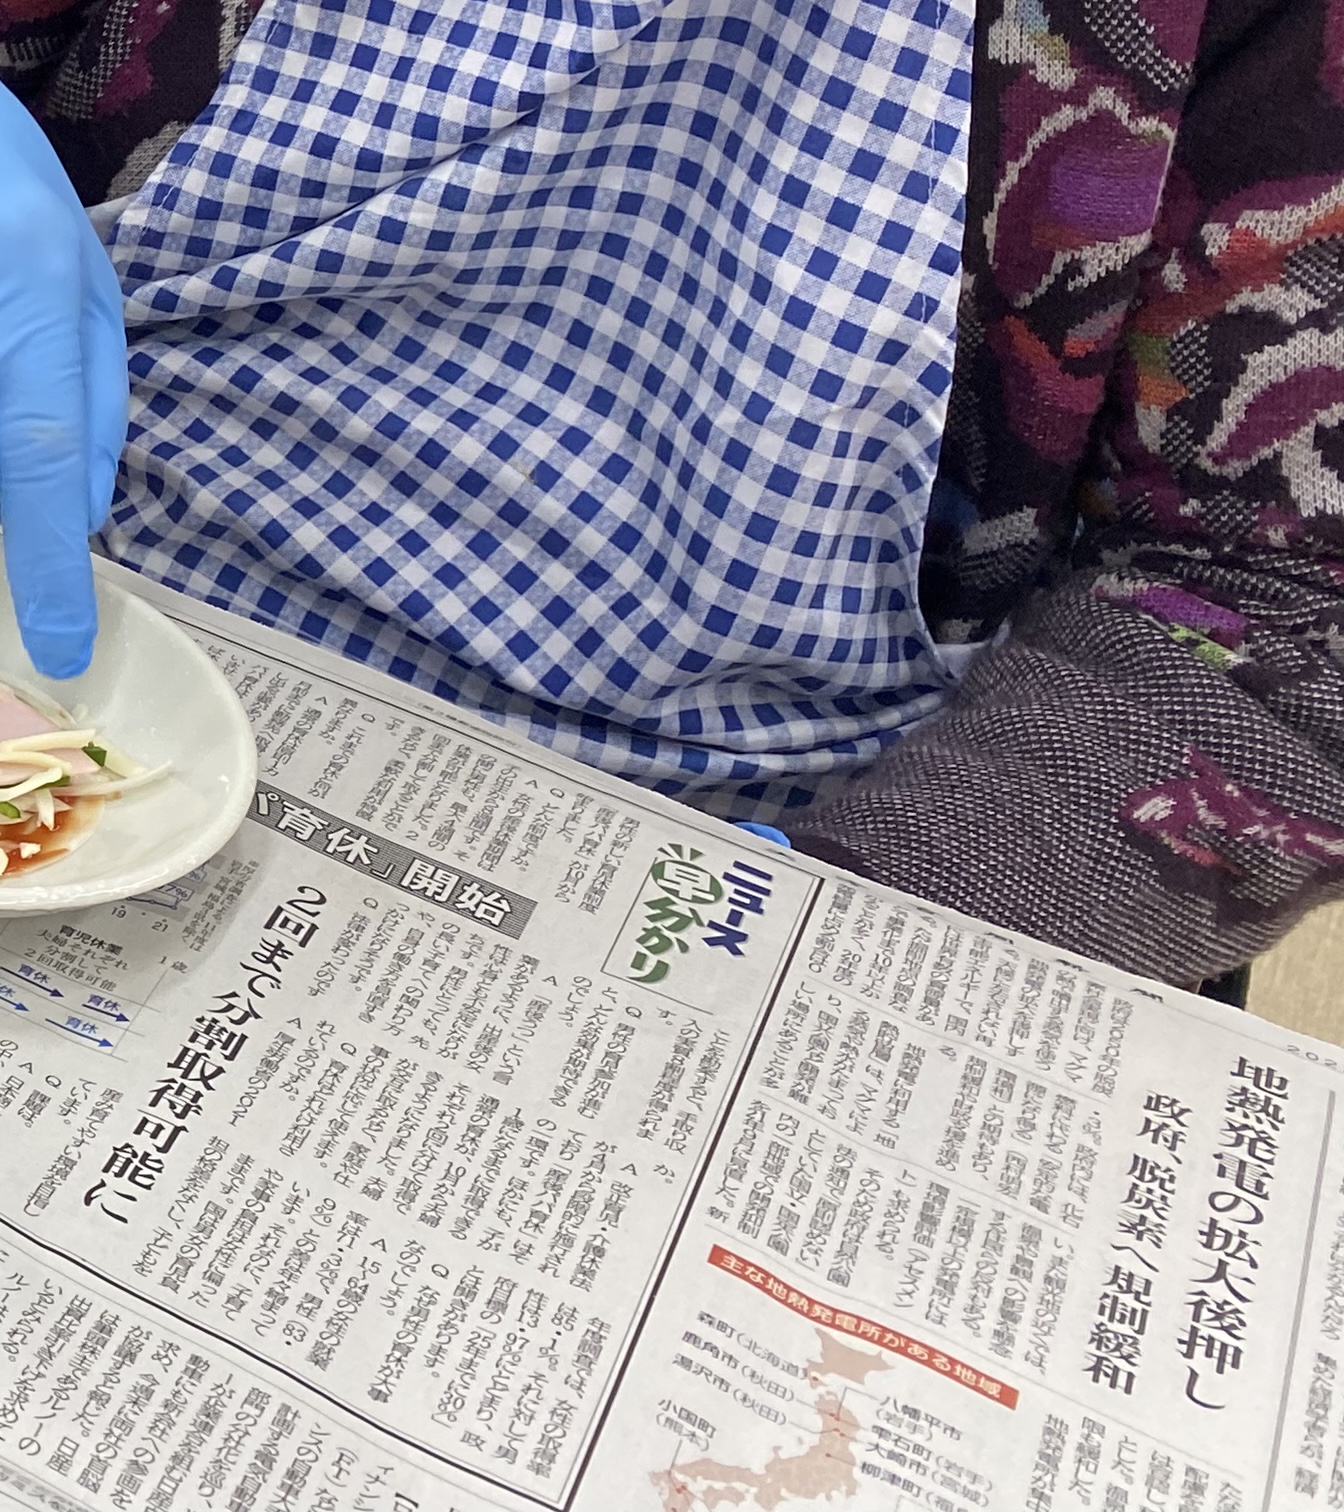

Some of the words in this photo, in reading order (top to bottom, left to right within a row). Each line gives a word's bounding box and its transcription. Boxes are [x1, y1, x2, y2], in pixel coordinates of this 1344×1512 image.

[626, 858, 724, 985] 早分かり
[700, 859, 774, 957] ニュース
[23, 947, 118, 992] 2回取得可能
[35, 928, 130, 971] 夫婦それぞれ
[45, 945, 107, 976] 分割して
[58, 924, 123, 957] 育児休業
[17, 963, 51, 986] 育休
[86, 994, 121, 1013] 育休
[63, 1014, 99, 1036] 育休
[79, 884, 329, 1227] 2回まで分割取得可能に
[275, 1017, 339, 1102] れているのですか。
[10, 1089, 53, 1129] 課題は。
[1082, 1089, 1194, 1397] 政府、脱炭素へ規制緩和
[1176, 1055, 1291, 1411] 地熱発電の拡大後押し
[373, 1237, 429, 1317] なのでしょう。
[1, 1279, 63, 1365] いるとみられる。
[719, 1253, 1002, 1400] 主な地熱発電所がある地域
[18, 1309, 120, 1457] は筆頭株主であるルノーの
[658, 1398, 718, 1439] 小国町
[879, 1396, 963, 1442] 八幡平市
